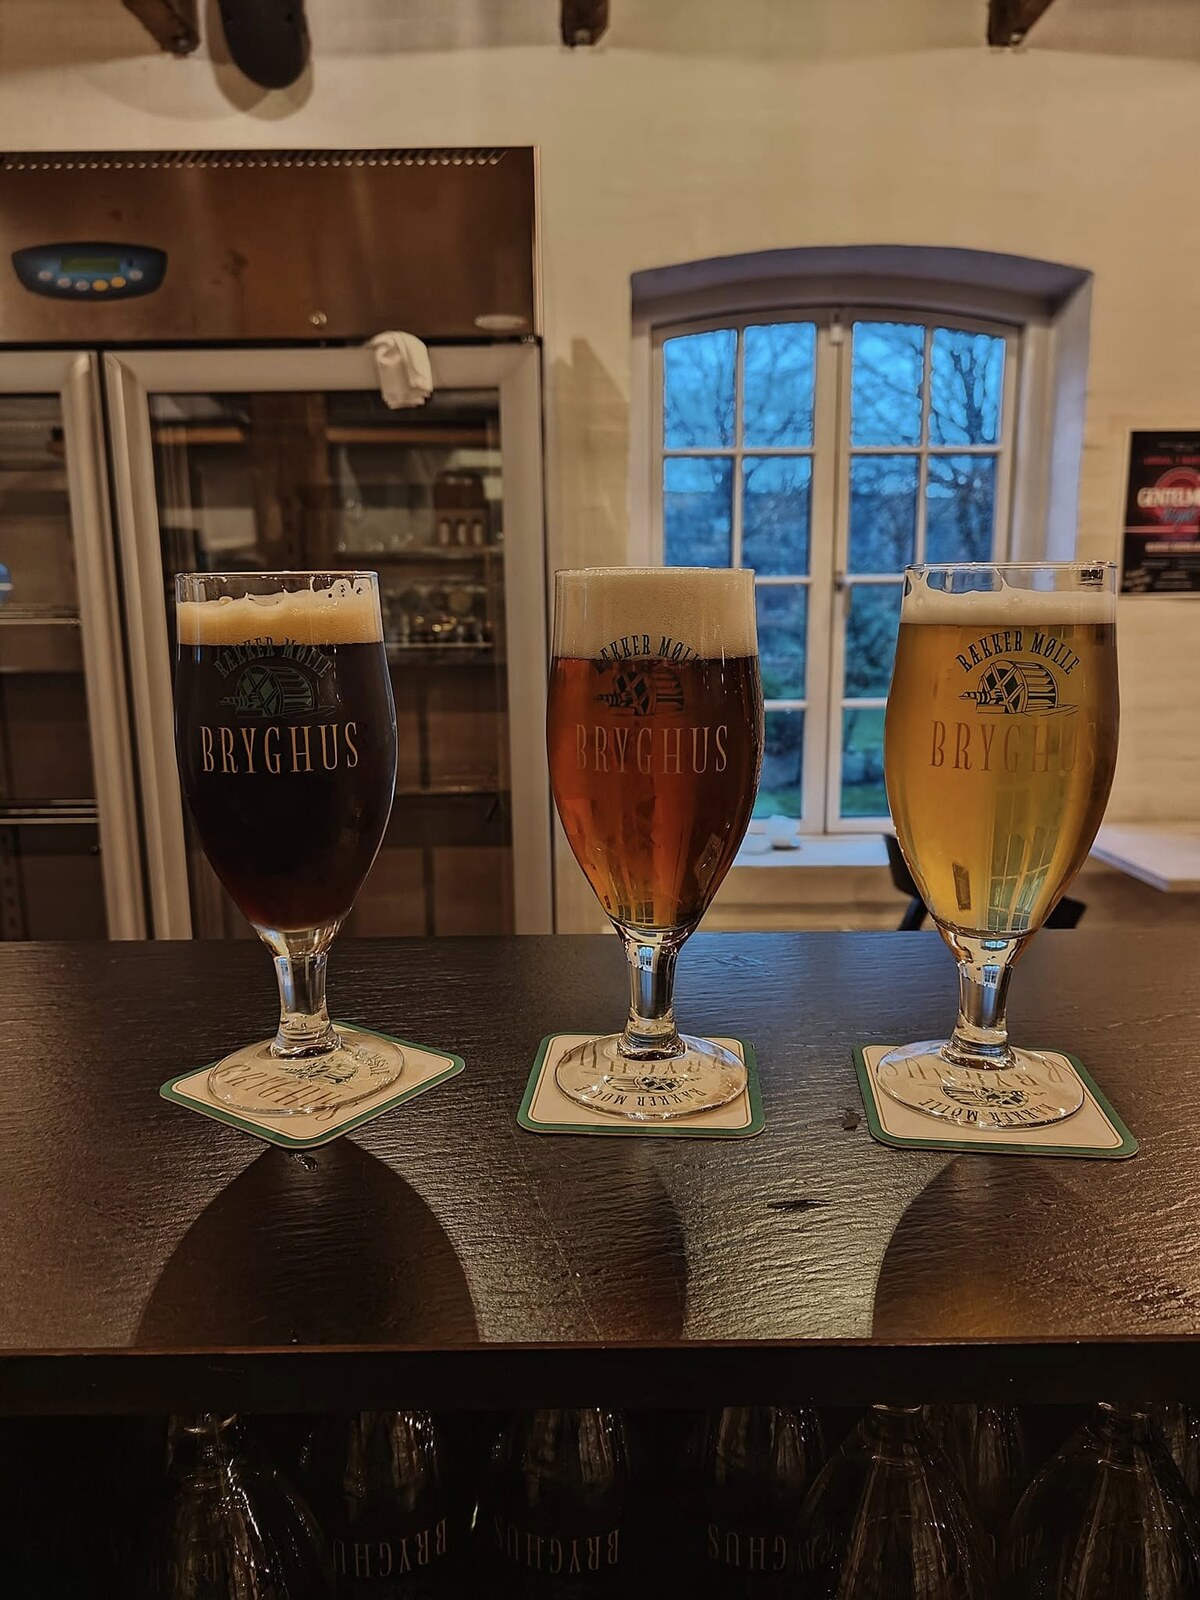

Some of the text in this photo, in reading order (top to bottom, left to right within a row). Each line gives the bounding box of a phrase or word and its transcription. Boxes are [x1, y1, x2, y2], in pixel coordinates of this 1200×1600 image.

[282, 637, 334, 679] MØLLE
[955, 630, 1081, 675] RÆKKER MØLLE
[200, 721, 359, 775] BRYGHUS
[575, 723, 729, 775] BRYGHUS
